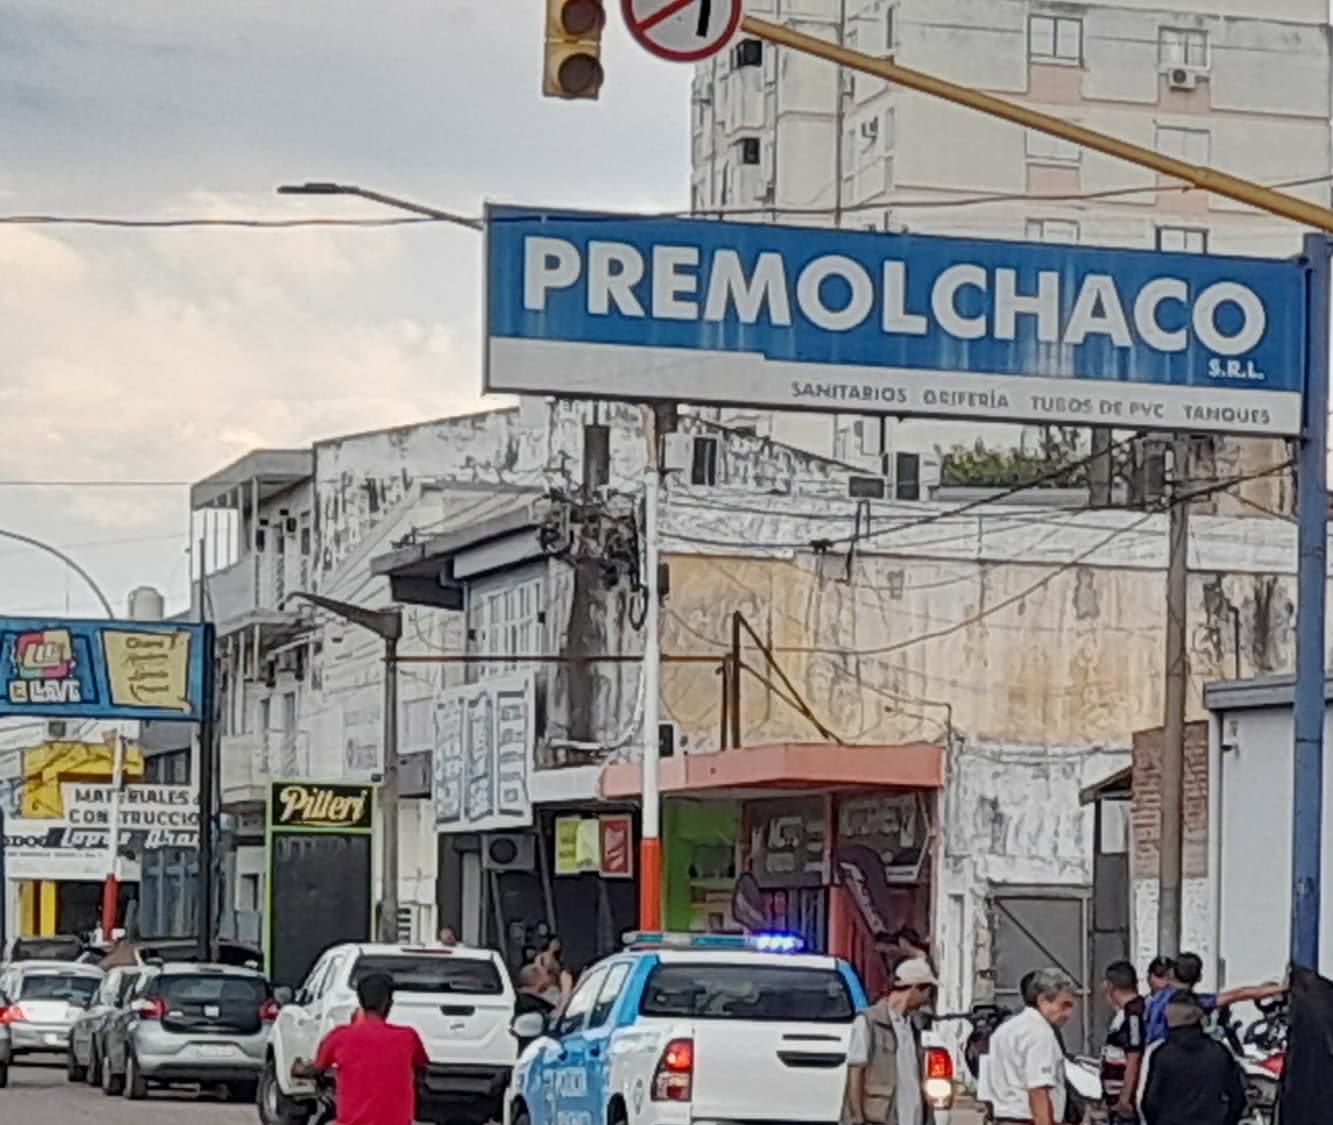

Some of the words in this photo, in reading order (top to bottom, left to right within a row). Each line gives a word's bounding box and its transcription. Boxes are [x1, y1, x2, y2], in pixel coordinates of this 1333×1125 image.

[522, 235, 1266, 356] PREMOLCHACO
[1207, 358, 1266, 380] S.R.L.
[791, 381, 907, 404] SANITARIOS
[1030, 395, 1092, 415] TUBOS
[1100, 399, 1123, 416] DE
[1130, 400, 1165, 419] PVC
[1183, 403, 1271, 425] TANQUES
